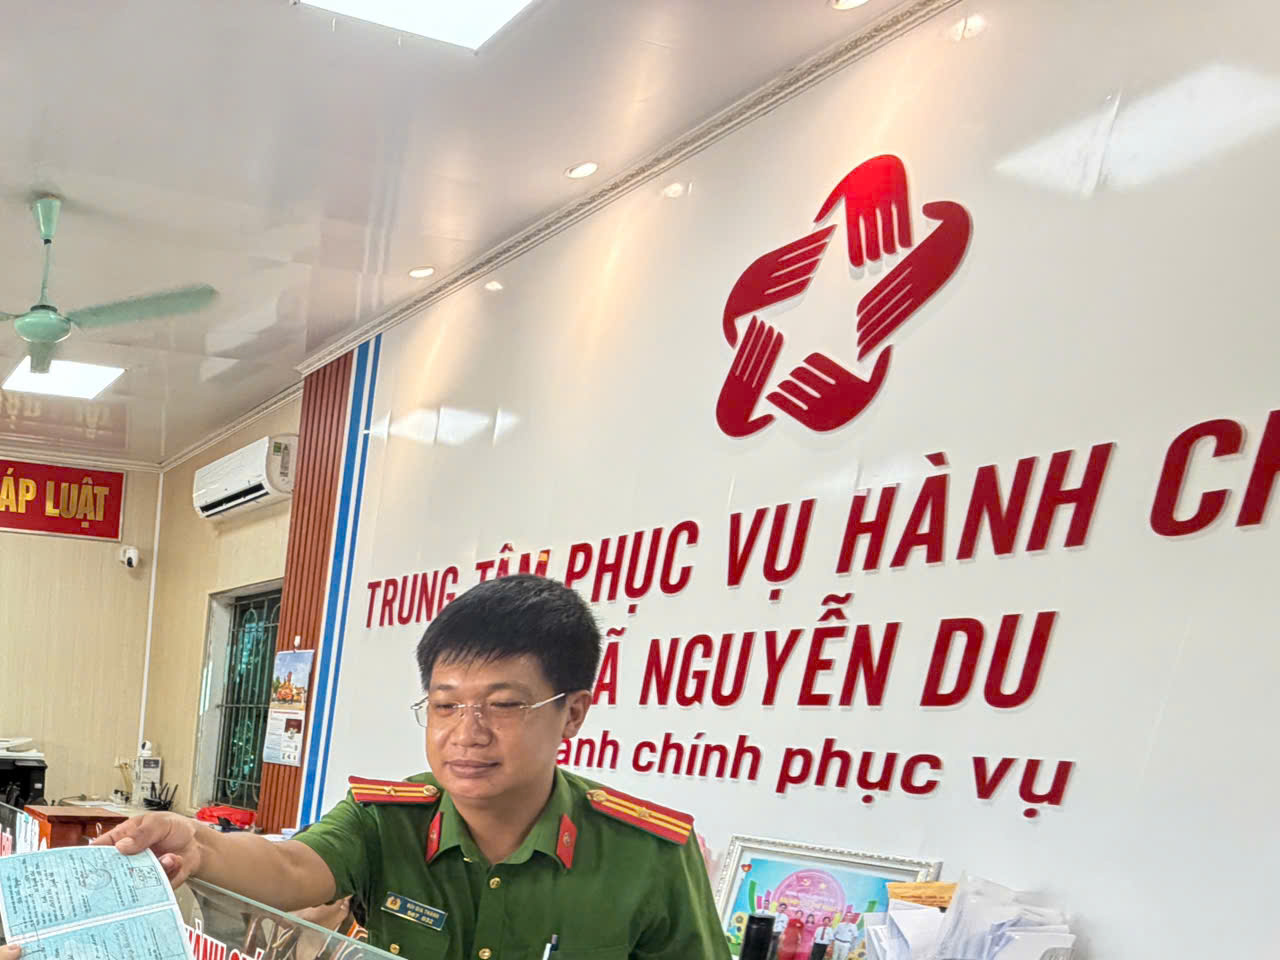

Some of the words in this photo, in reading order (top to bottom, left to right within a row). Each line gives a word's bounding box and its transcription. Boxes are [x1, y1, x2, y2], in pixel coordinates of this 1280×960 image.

[45, 478, 109, 526] LUẬT
[366, 565, 460, 630] TRUNG
[564, 520, 699, 614] PHỤC
[727, 498, 817, 602] VỤ
[835, 441, 1117, 575] HÀNH
[592, 627, 626, 706] Ã
[639, 592, 902, 707] NGUYỄN
[920, 610, 1057, 709] DU
[632, 731, 762, 781] chính
[776, 738, 943, 804] phục
[972, 755, 1076, 819] vụ
